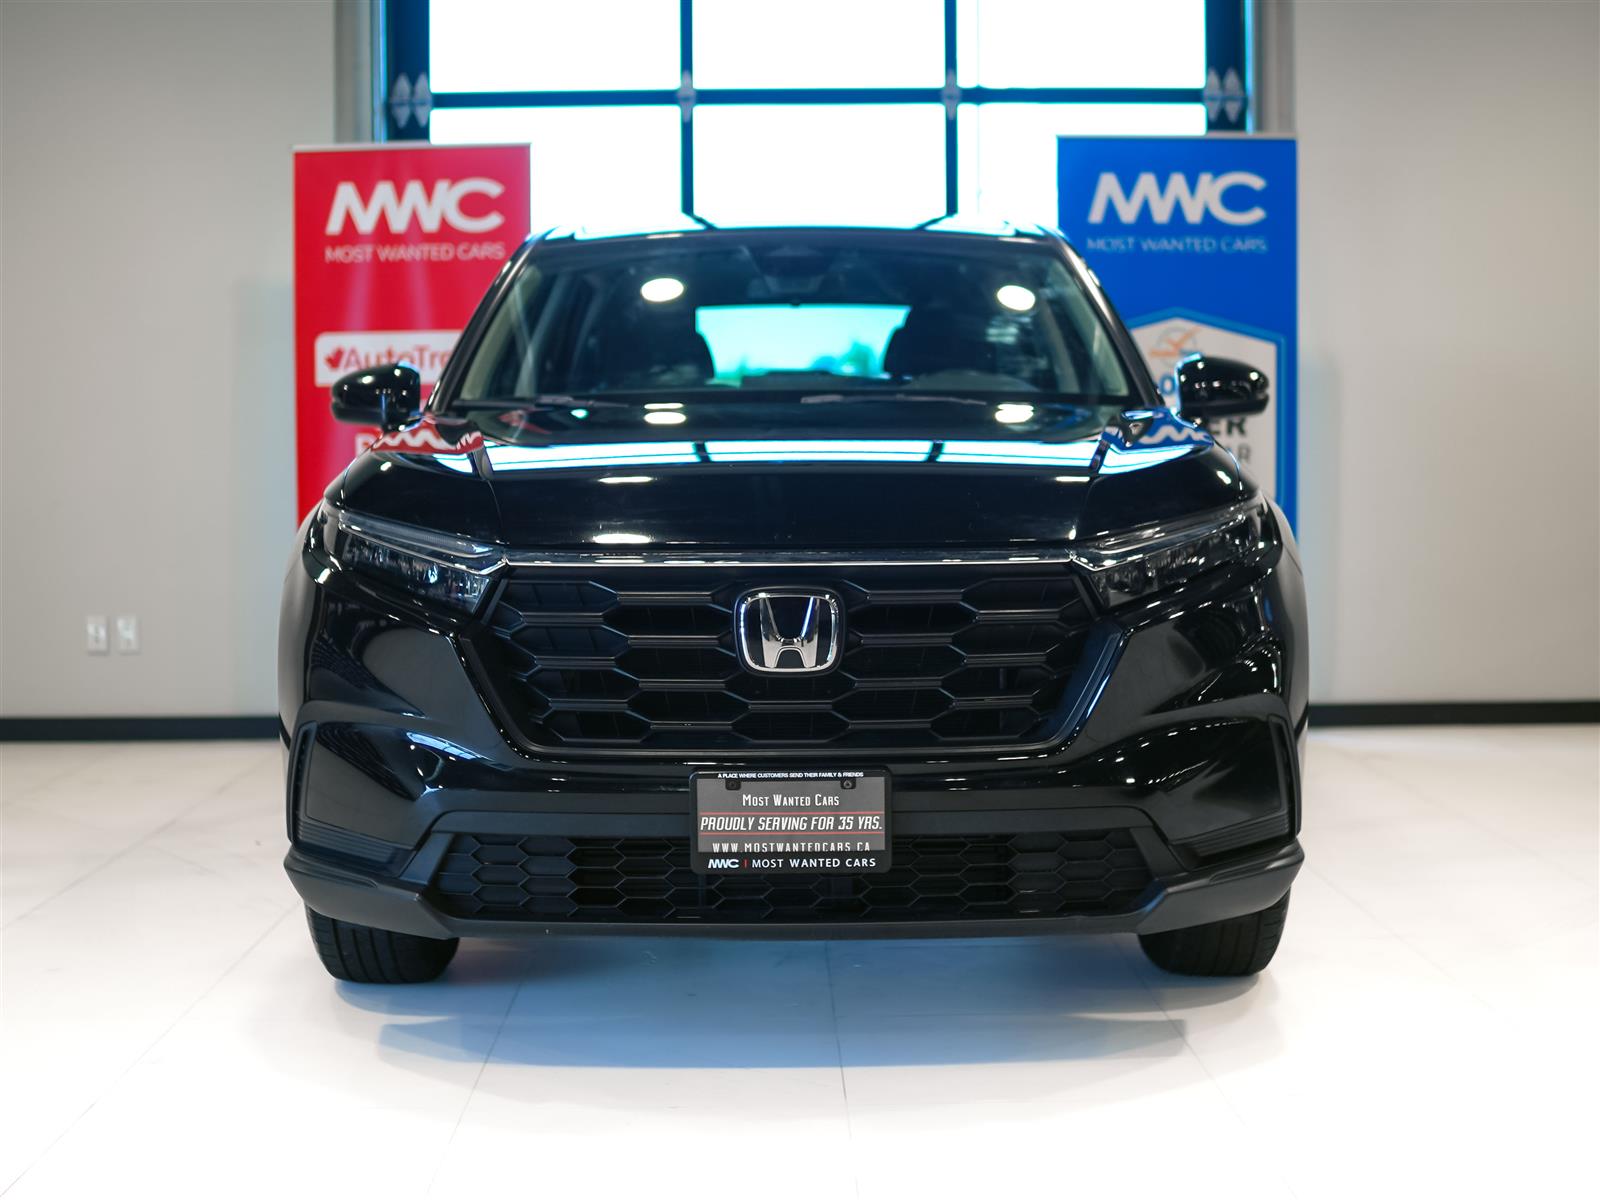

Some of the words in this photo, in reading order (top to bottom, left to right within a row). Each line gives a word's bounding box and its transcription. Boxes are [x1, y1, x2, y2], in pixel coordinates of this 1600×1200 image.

[324, 177, 505, 236] MWC
[1087, 172, 1267, 226] MWC
[1087, 237, 1135, 250] MOST
[1140, 237, 1216, 252] WANTED
[1220, 236, 1268, 252] CARS
[324, 244, 374, 264] MOST
[376, 243, 455, 262] WANTED
[457, 241, 506, 260] CARS
[700, 816, 755, 831] PROUDLY
[757, 816, 808, 830] SERVING
[810, 816, 834, 830] FOR
[838, 815, 853, 830] 35
[857, 815, 883, 830] YRS.
[712, 842, 870, 853] WWW.MOSTWANTEDCARSCA
[707, 858, 740, 869] MWC
[751, 858, 784, 868] MOST
[789, 858, 841, 868] WANTED
[845, 858, 876, 868] CARS
